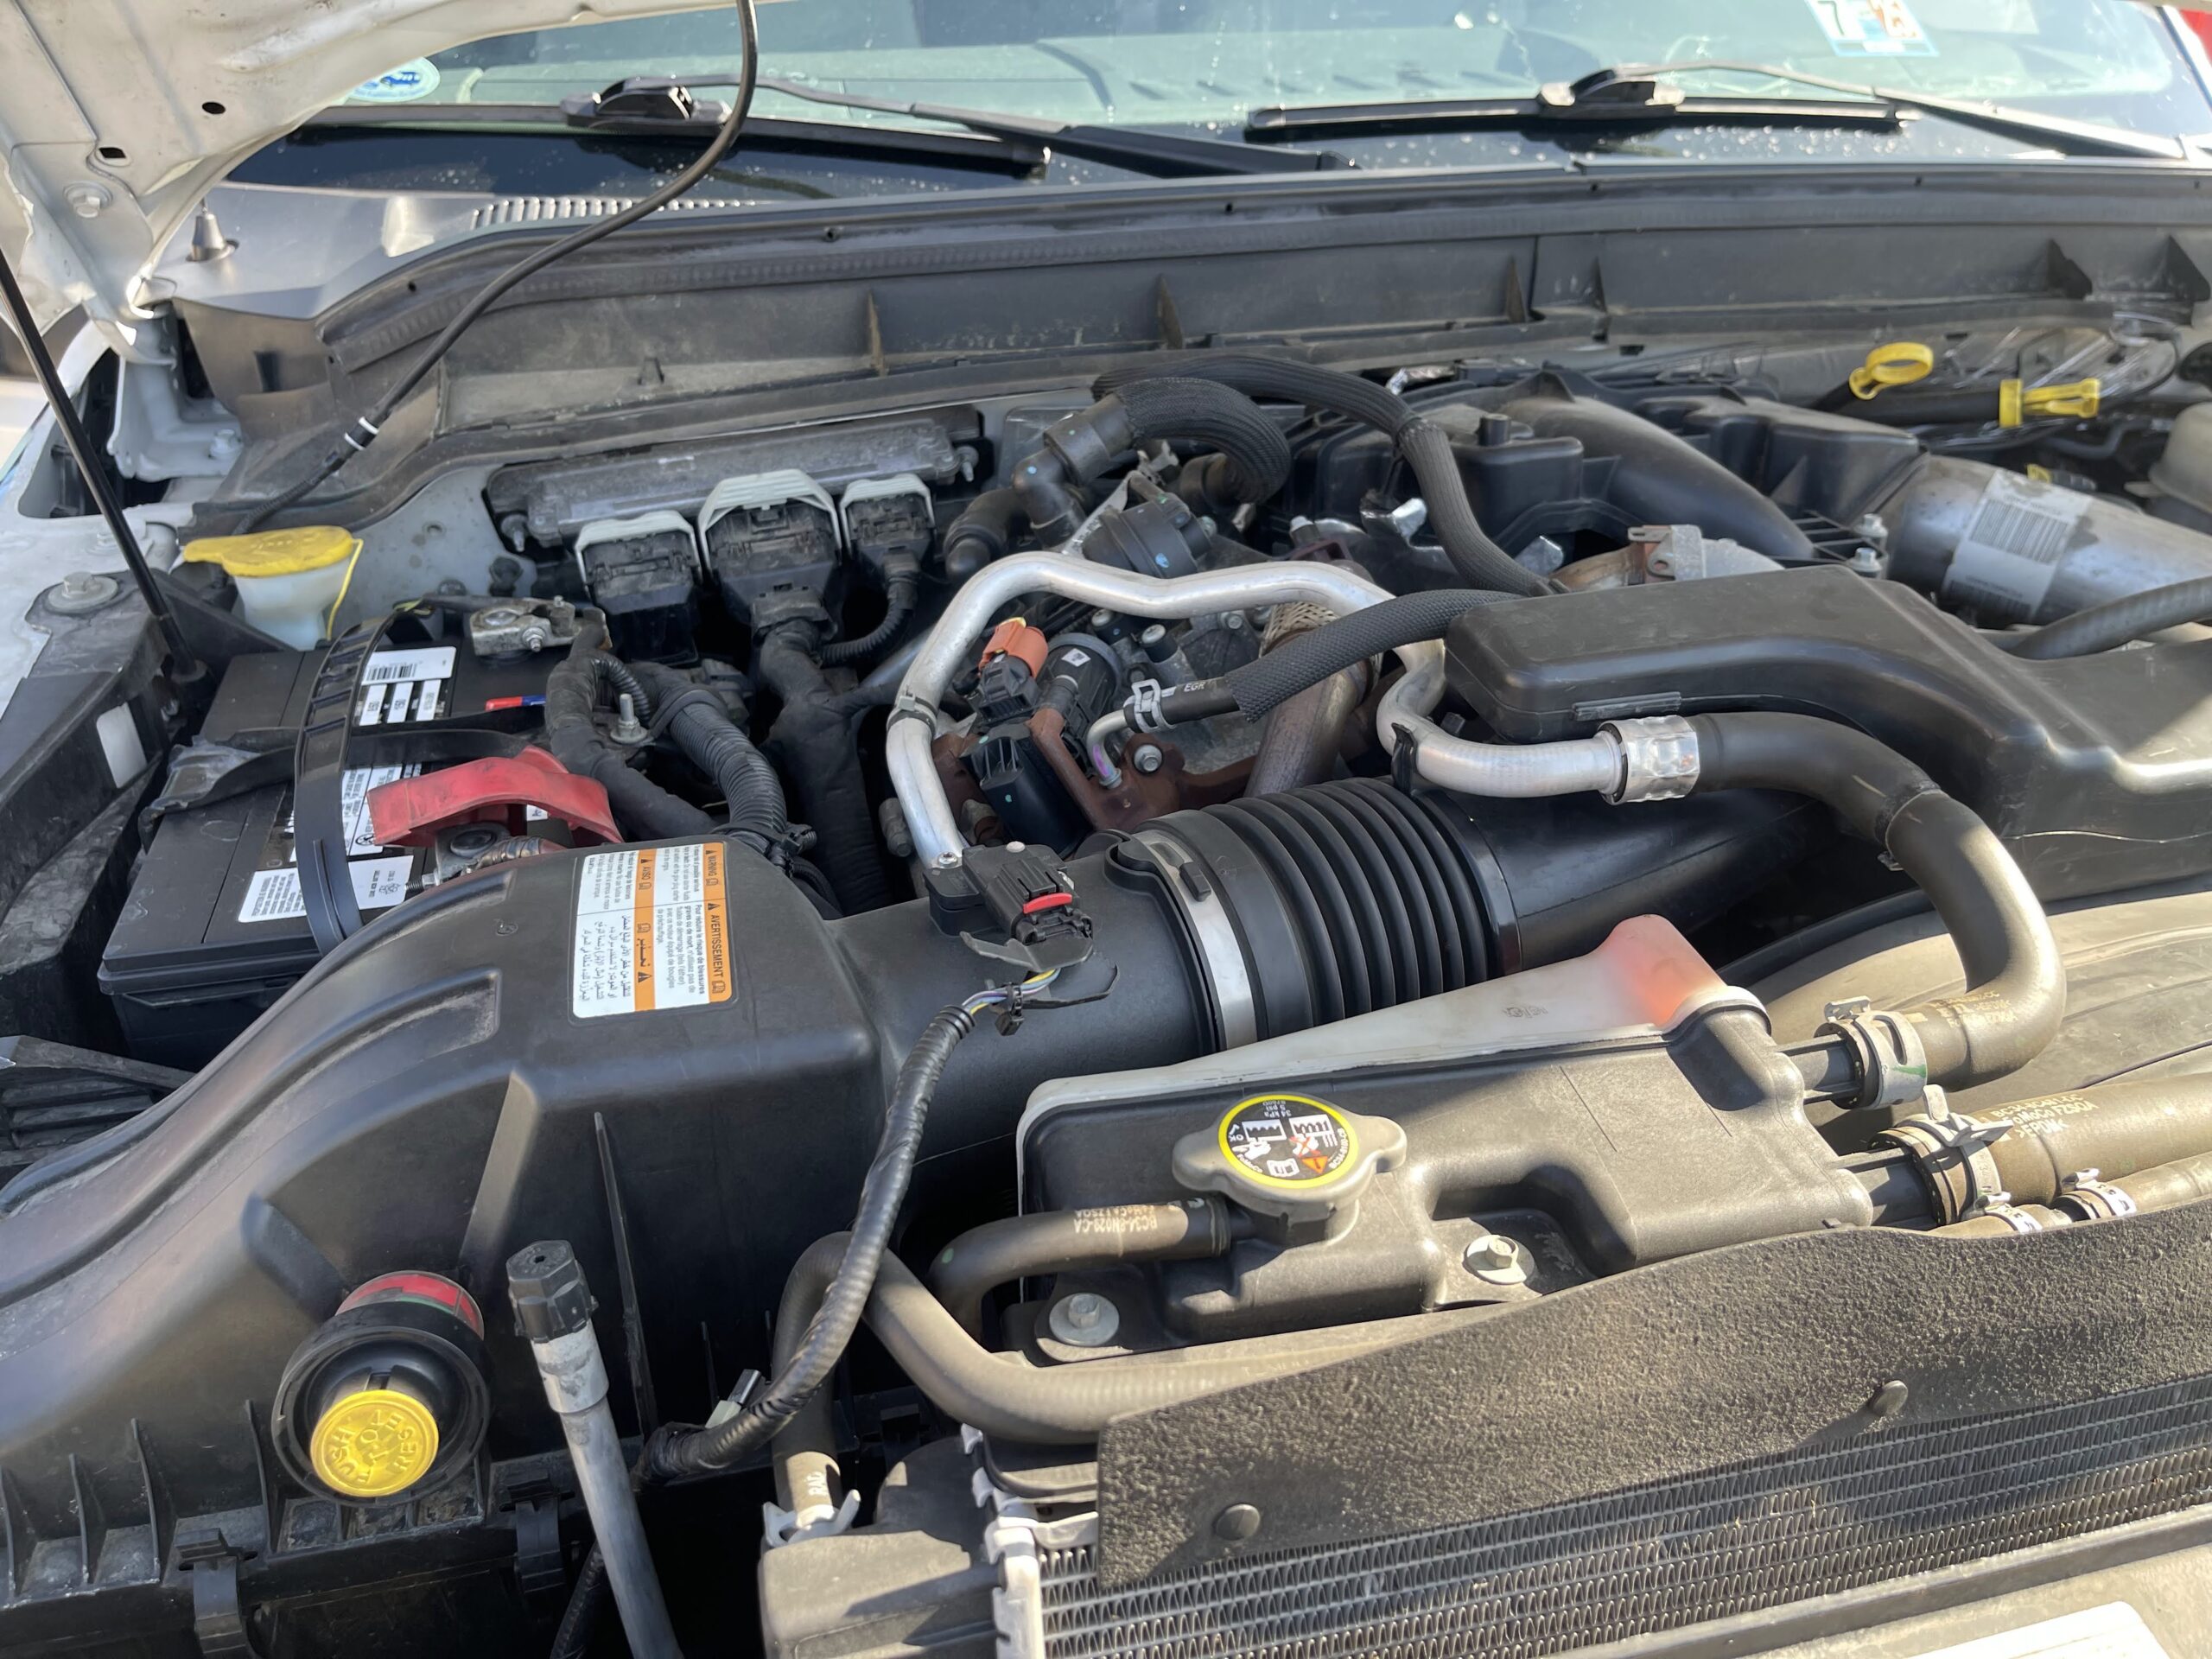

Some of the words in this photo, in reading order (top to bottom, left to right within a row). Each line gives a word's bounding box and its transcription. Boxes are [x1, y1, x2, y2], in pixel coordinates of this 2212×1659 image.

[640, 865, 651, 880] AVISO
[707, 855, 718, 876] WARNING
[694, 938, 703, 956] risque
[709, 913, 723, 978] AVERTISSEMENT
[665, 965, 676, 988] bougies
[685, 973, 694, 984] pas
[696, 964, 706, 995] blessures
[688, 984, 696, 993] de
[1228, 1134, 1244, 1142] OK
